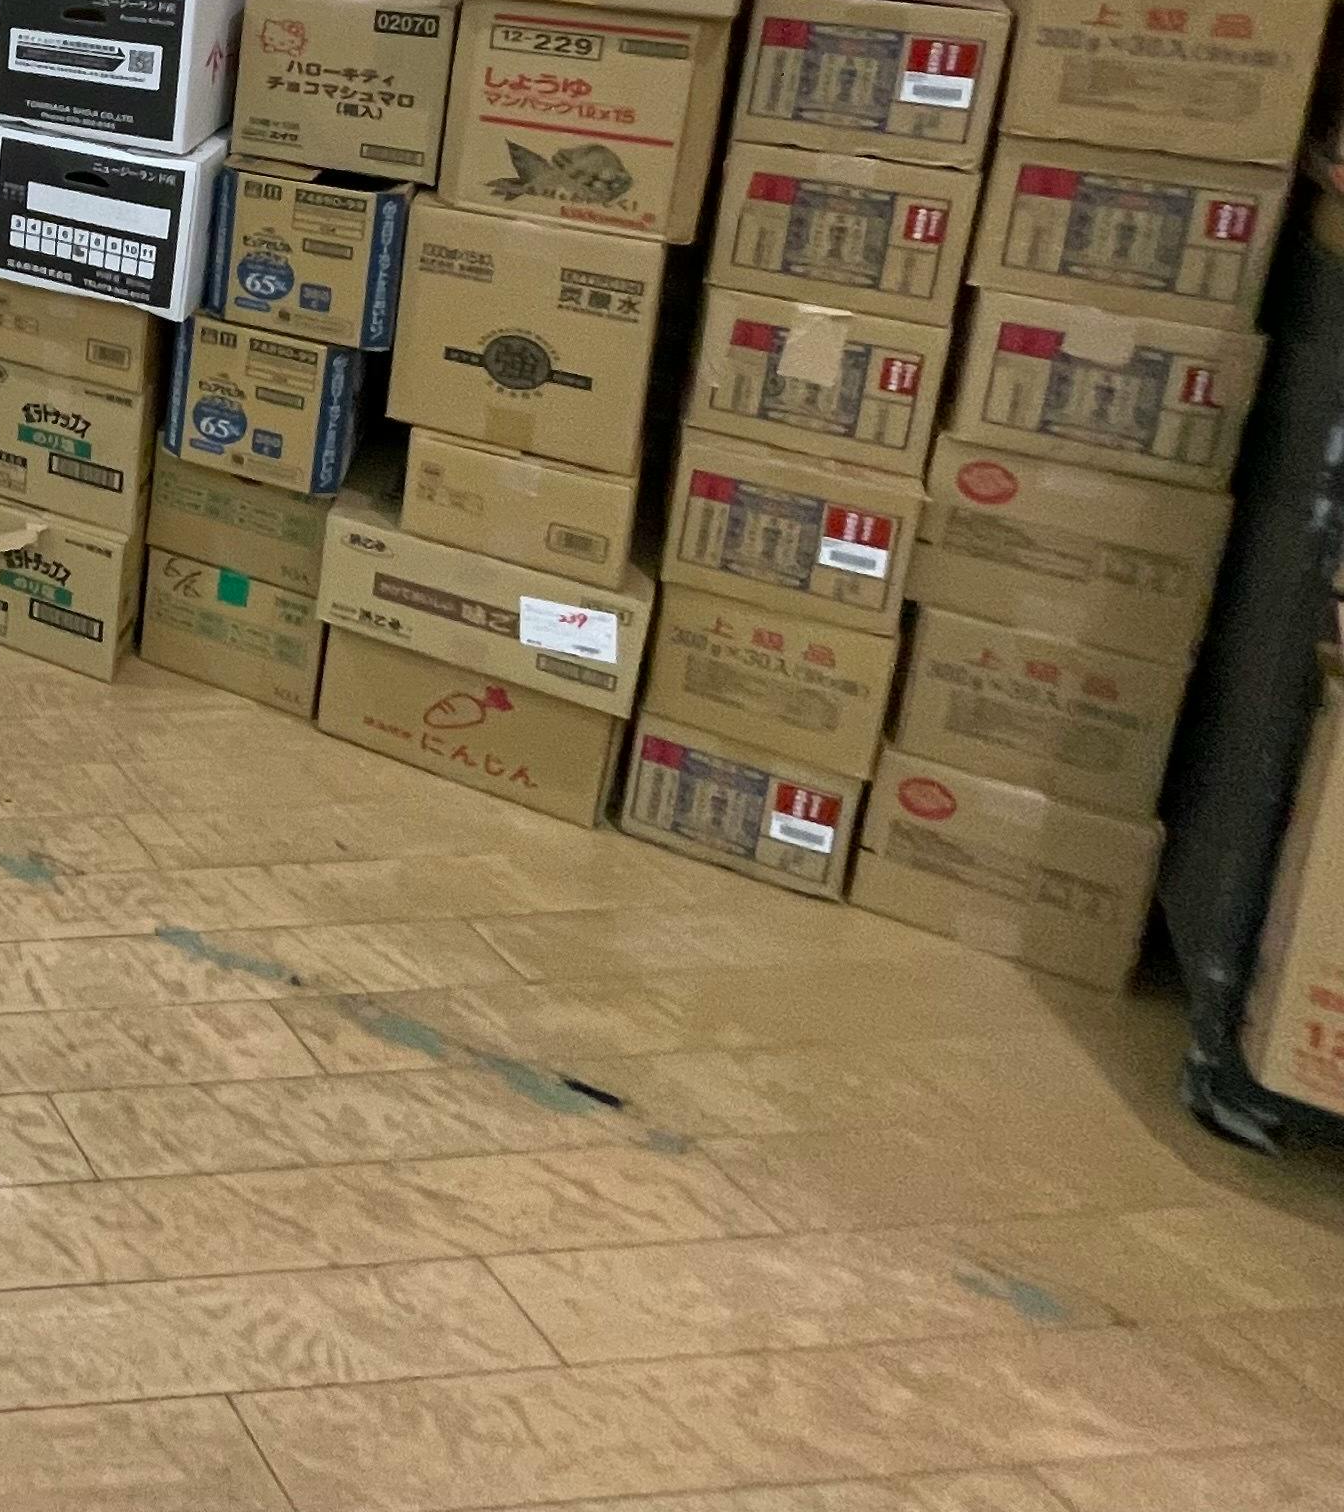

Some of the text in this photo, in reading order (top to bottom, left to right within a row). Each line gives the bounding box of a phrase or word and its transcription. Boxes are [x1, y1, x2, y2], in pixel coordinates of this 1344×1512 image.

[377, 13, 436, 35] 02070
[501, 28, 594, 56] 12-229
[286, 59, 396, 87] ハローキティ
[484, 66, 594, 98] しょうゆ
[266, 75, 416, 109] チョコマシュマロ
[420, 732, 539, 789] にんじん
